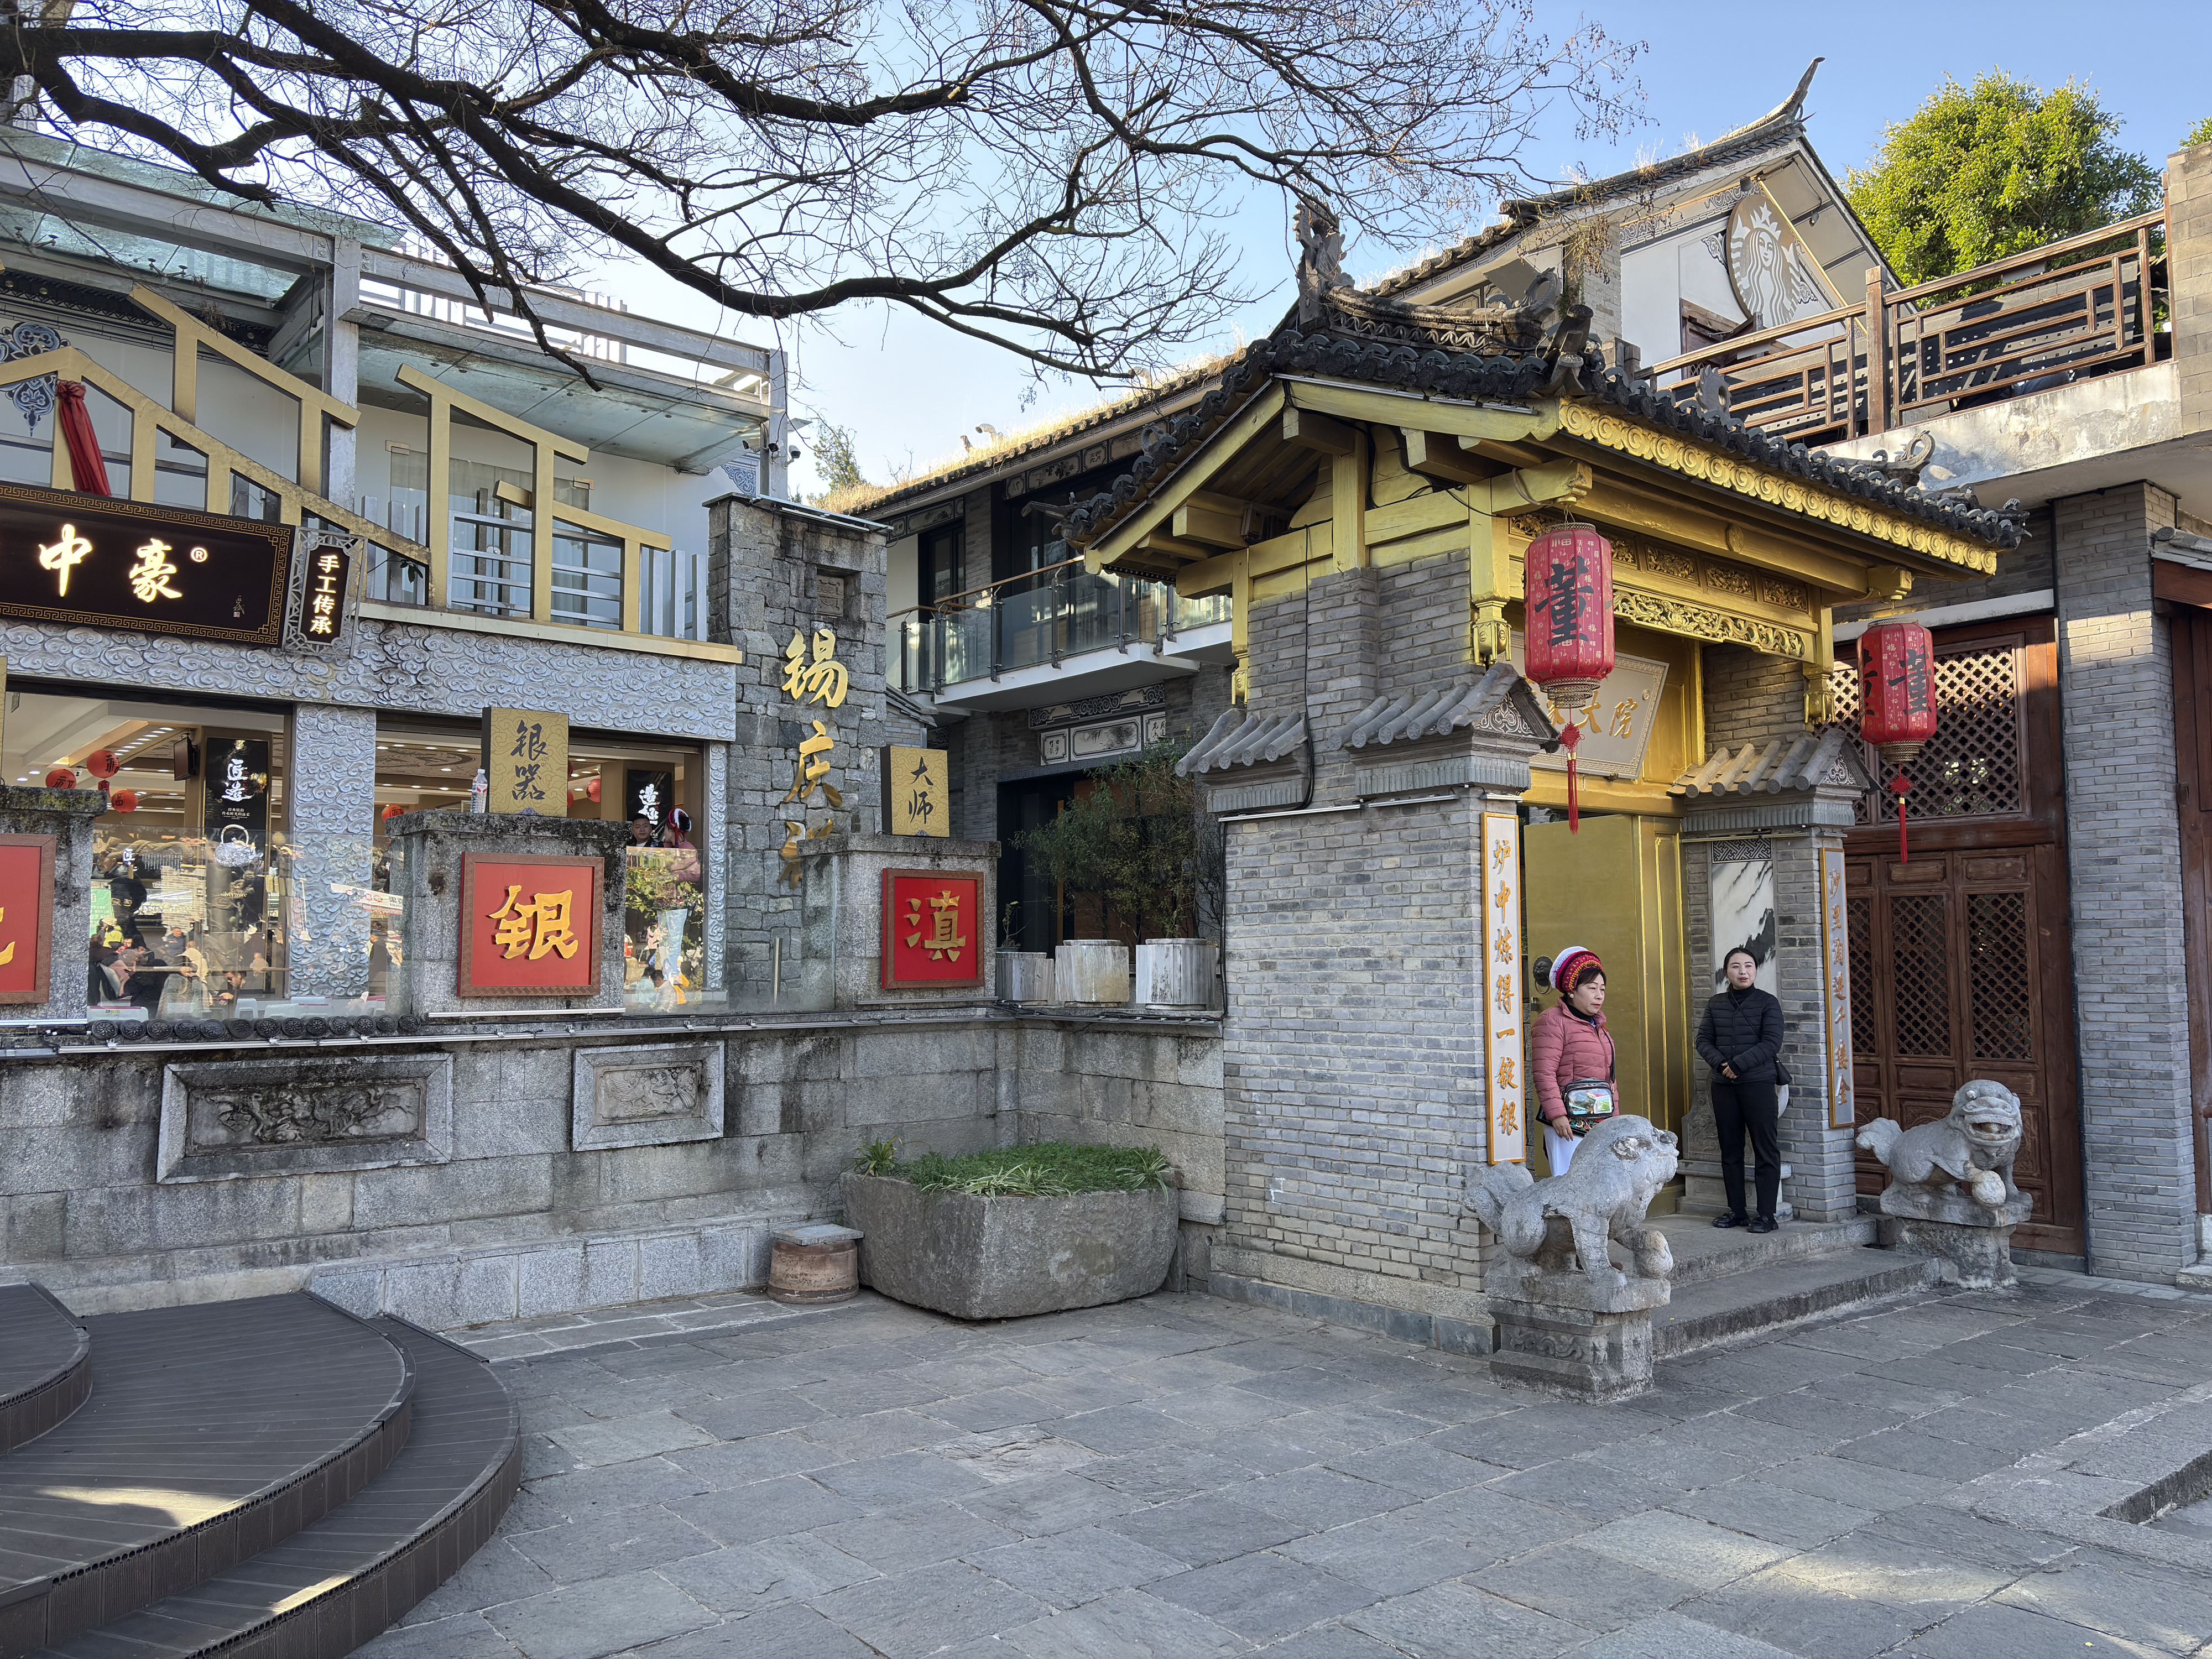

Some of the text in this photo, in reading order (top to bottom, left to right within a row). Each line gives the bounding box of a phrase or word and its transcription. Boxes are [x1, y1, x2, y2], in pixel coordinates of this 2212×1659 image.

[310, 555, 340, 634] 手工传承
[510, 719, 549, 800] 银器
[908, 757, 933, 824] 大师
[489, 885, 578, 961] 银
[905, 890, 966, 962] 滇
